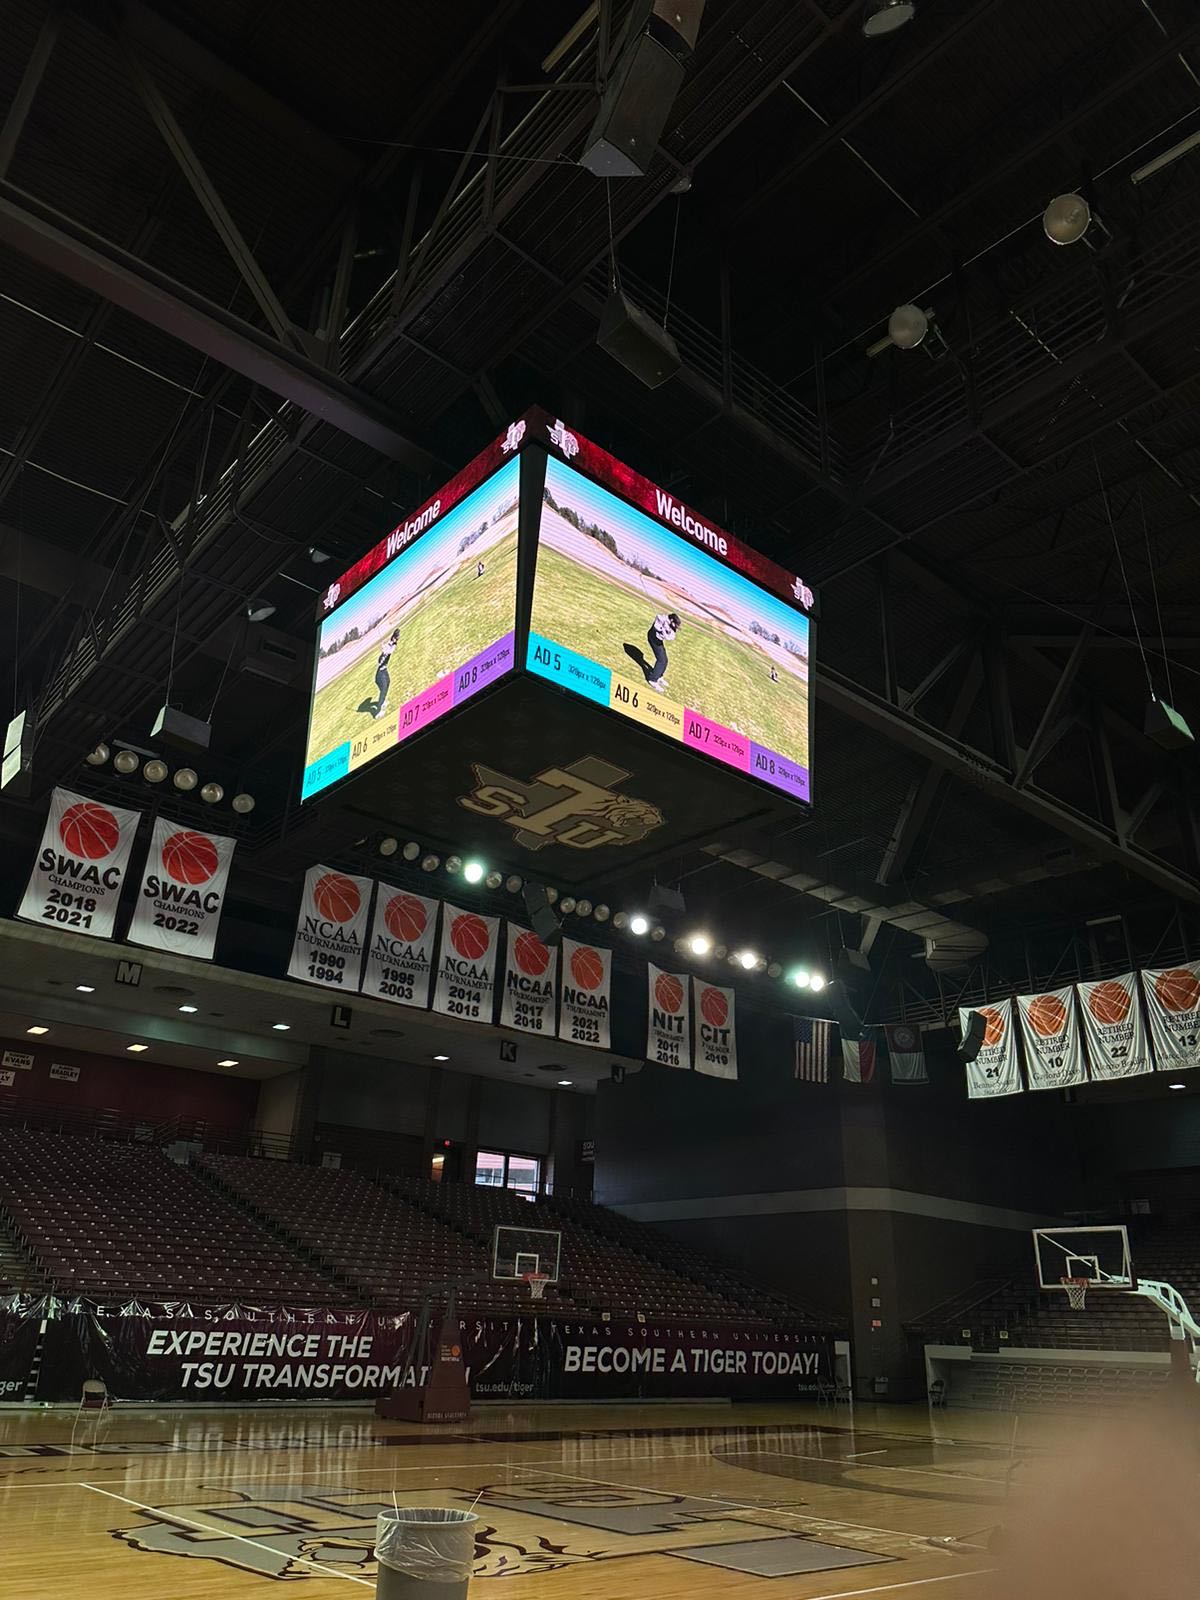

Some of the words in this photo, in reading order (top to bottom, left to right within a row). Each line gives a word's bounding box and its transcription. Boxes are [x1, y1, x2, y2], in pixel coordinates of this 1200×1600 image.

[386, 499, 441, 559] Welcome
[656, 489, 728, 556] Welcome
[534, 645, 551, 666] AD
[554, 654, 561, 671] 5
[458, 671, 470, 692] AD
[471, 666, 478, 683] 8
[614, 683, 630, 703] AD
[632, 692, 639, 708] 6
[402, 709, 413, 729] AD
[414, 704, 420, 721] 7
[688, 720, 702, 739] AD
[704, 728, 711, 743] 7
[363, 737, 368, 753] 6
[755, 753, 768, 771] AD
[769, 759, 776, 774] 8
[40, 848, 120, 889] SWAC
[49, 874, 105, 895] CHAMPIONS
[144, 875, 219, 913] SWAC
[47, 889, 97, 912] 2018
[153, 899, 205, 919] CHAMPIONS
[42, 905, 93, 928] 2021
[153, 913, 199, 936] 2022
[303, 915, 359, 945] NCAA
[297, 931, 361, 955] TOURNAMENT
[375, 934, 428, 963] NCAA
[310, 950, 345, 969] 1990
[445, 955, 488, 981] NCAA
[116, 960, 143, 986] M
[308, 964, 343, 983] 1994
[382, 967, 415, 986] 1995
[379, 981, 413, 999] 2003
[449, 986, 481, 1003] 2014
[507, 970, 553, 999] NCAA
[447, 1000, 479, 1017] 2015
[515, 1001, 544, 1016] 2017
[564, 985, 608, 1011] NCAA
[332, 1005, 351, 1027] L
[514, 1014, 542, 1030] 2018
[572, 1015, 598, 1030] 2021
[653, 1008, 685, 1033] NIT
[571, 1028, 600, 1043] 2022
[701, 1024, 730, 1045] CIT
[1099, 1031, 1135, 1043] NUMBER
[1178, 1034, 1198, 1047] 13
[501, 1040, 517, 1062] K
[657, 1039, 679, 1053] 2011
[1111, 1046, 1128, 1058] 22
[986, 1067, 1000, 1078] 21
[1048, 1056, 1063, 1068] 10
[146, 1330, 321, 1358] EXPERIENCE
[327, 1335, 373, 1358] THE
[627, 1327, 720, 1340] SOUTHERN
[733, 1331, 827, 1344] UNIVERSITY
[564, 1345, 667, 1374] BECOME
[669, 1348, 688, 1373] A
[690, 1348, 748, 1374] TIGER
[751, 1351, 820, 1375] TODAY!
[180, 1362, 236, 1389] TSU
[475, 1381, 534, 1396] tsu.edu/tiger
